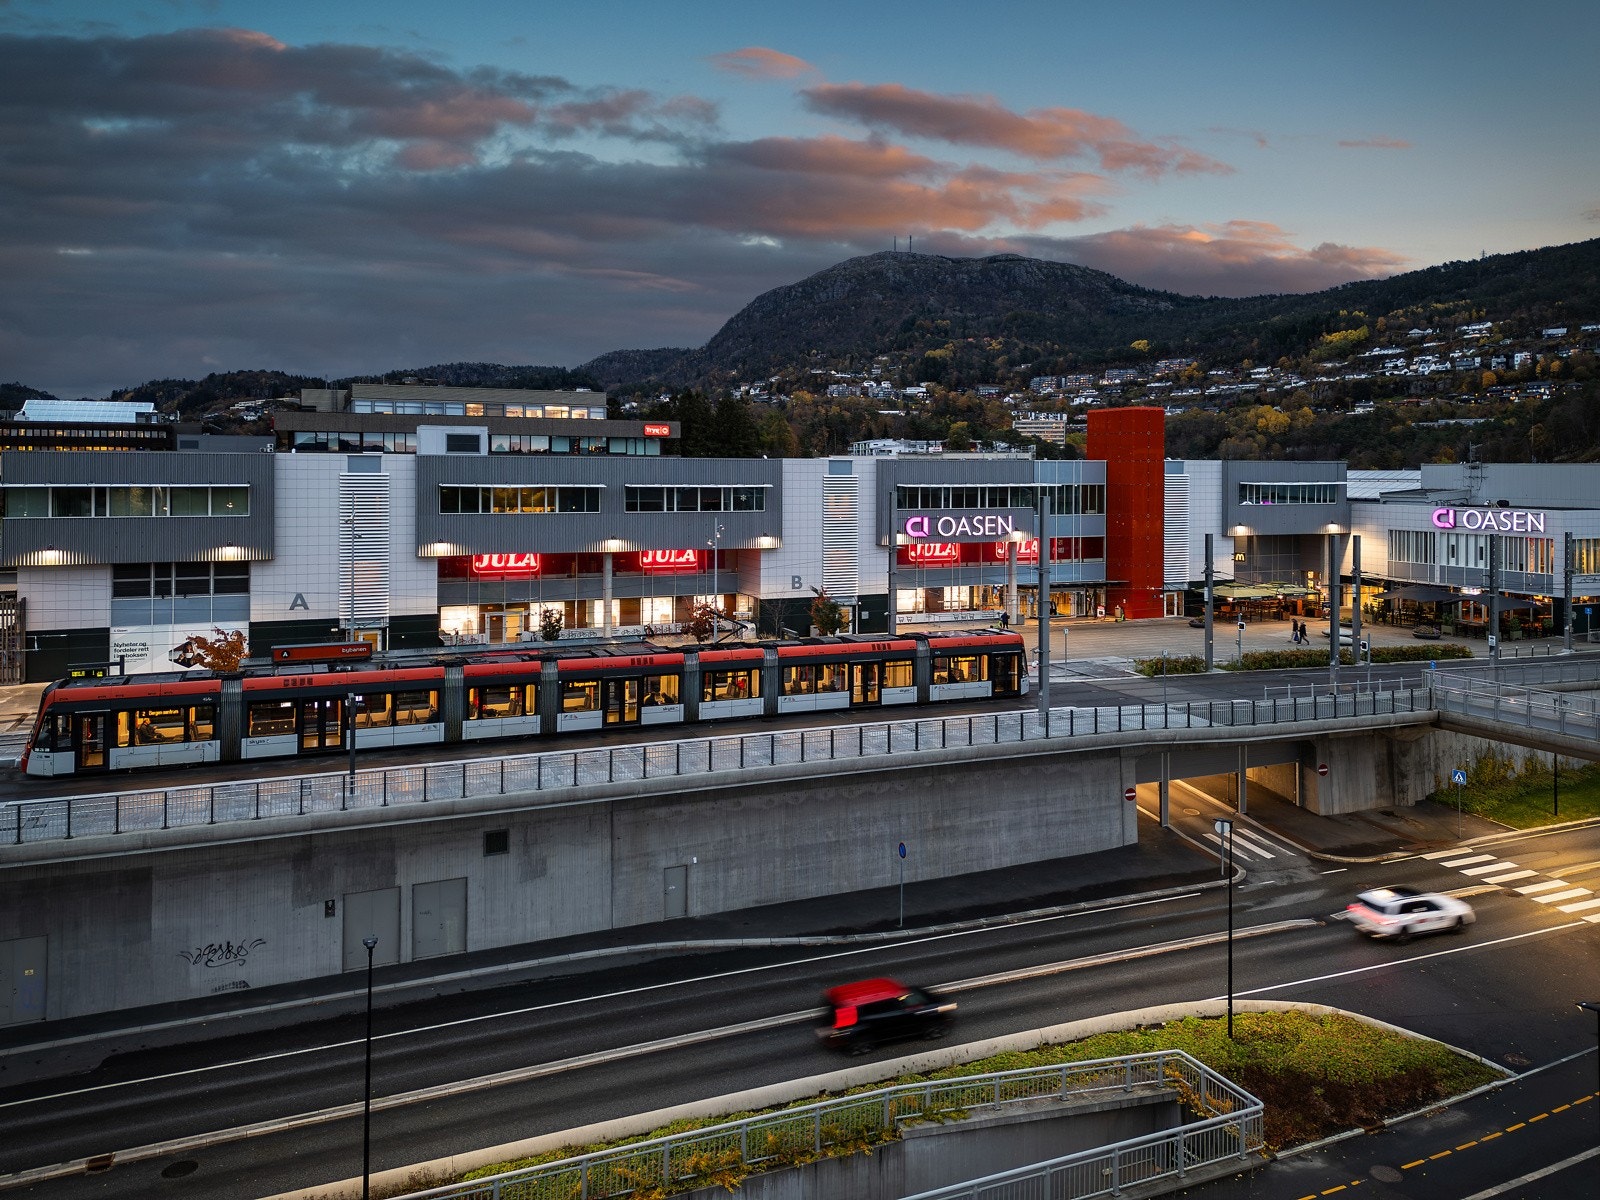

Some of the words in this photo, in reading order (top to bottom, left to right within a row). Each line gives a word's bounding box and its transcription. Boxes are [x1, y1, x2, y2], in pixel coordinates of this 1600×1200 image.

[937, 515, 1012, 536] OASEN
[1463, 510, 1545, 533] OASEN
[643, 550, 696, 563] JULA
[910, 542, 957, 557] JULA
[475, 553, 537, 567] JULA
[792, 575, 803, 590] B
[289, 593, 310, 611] A
[341, 646, 368, 654] bybanen
